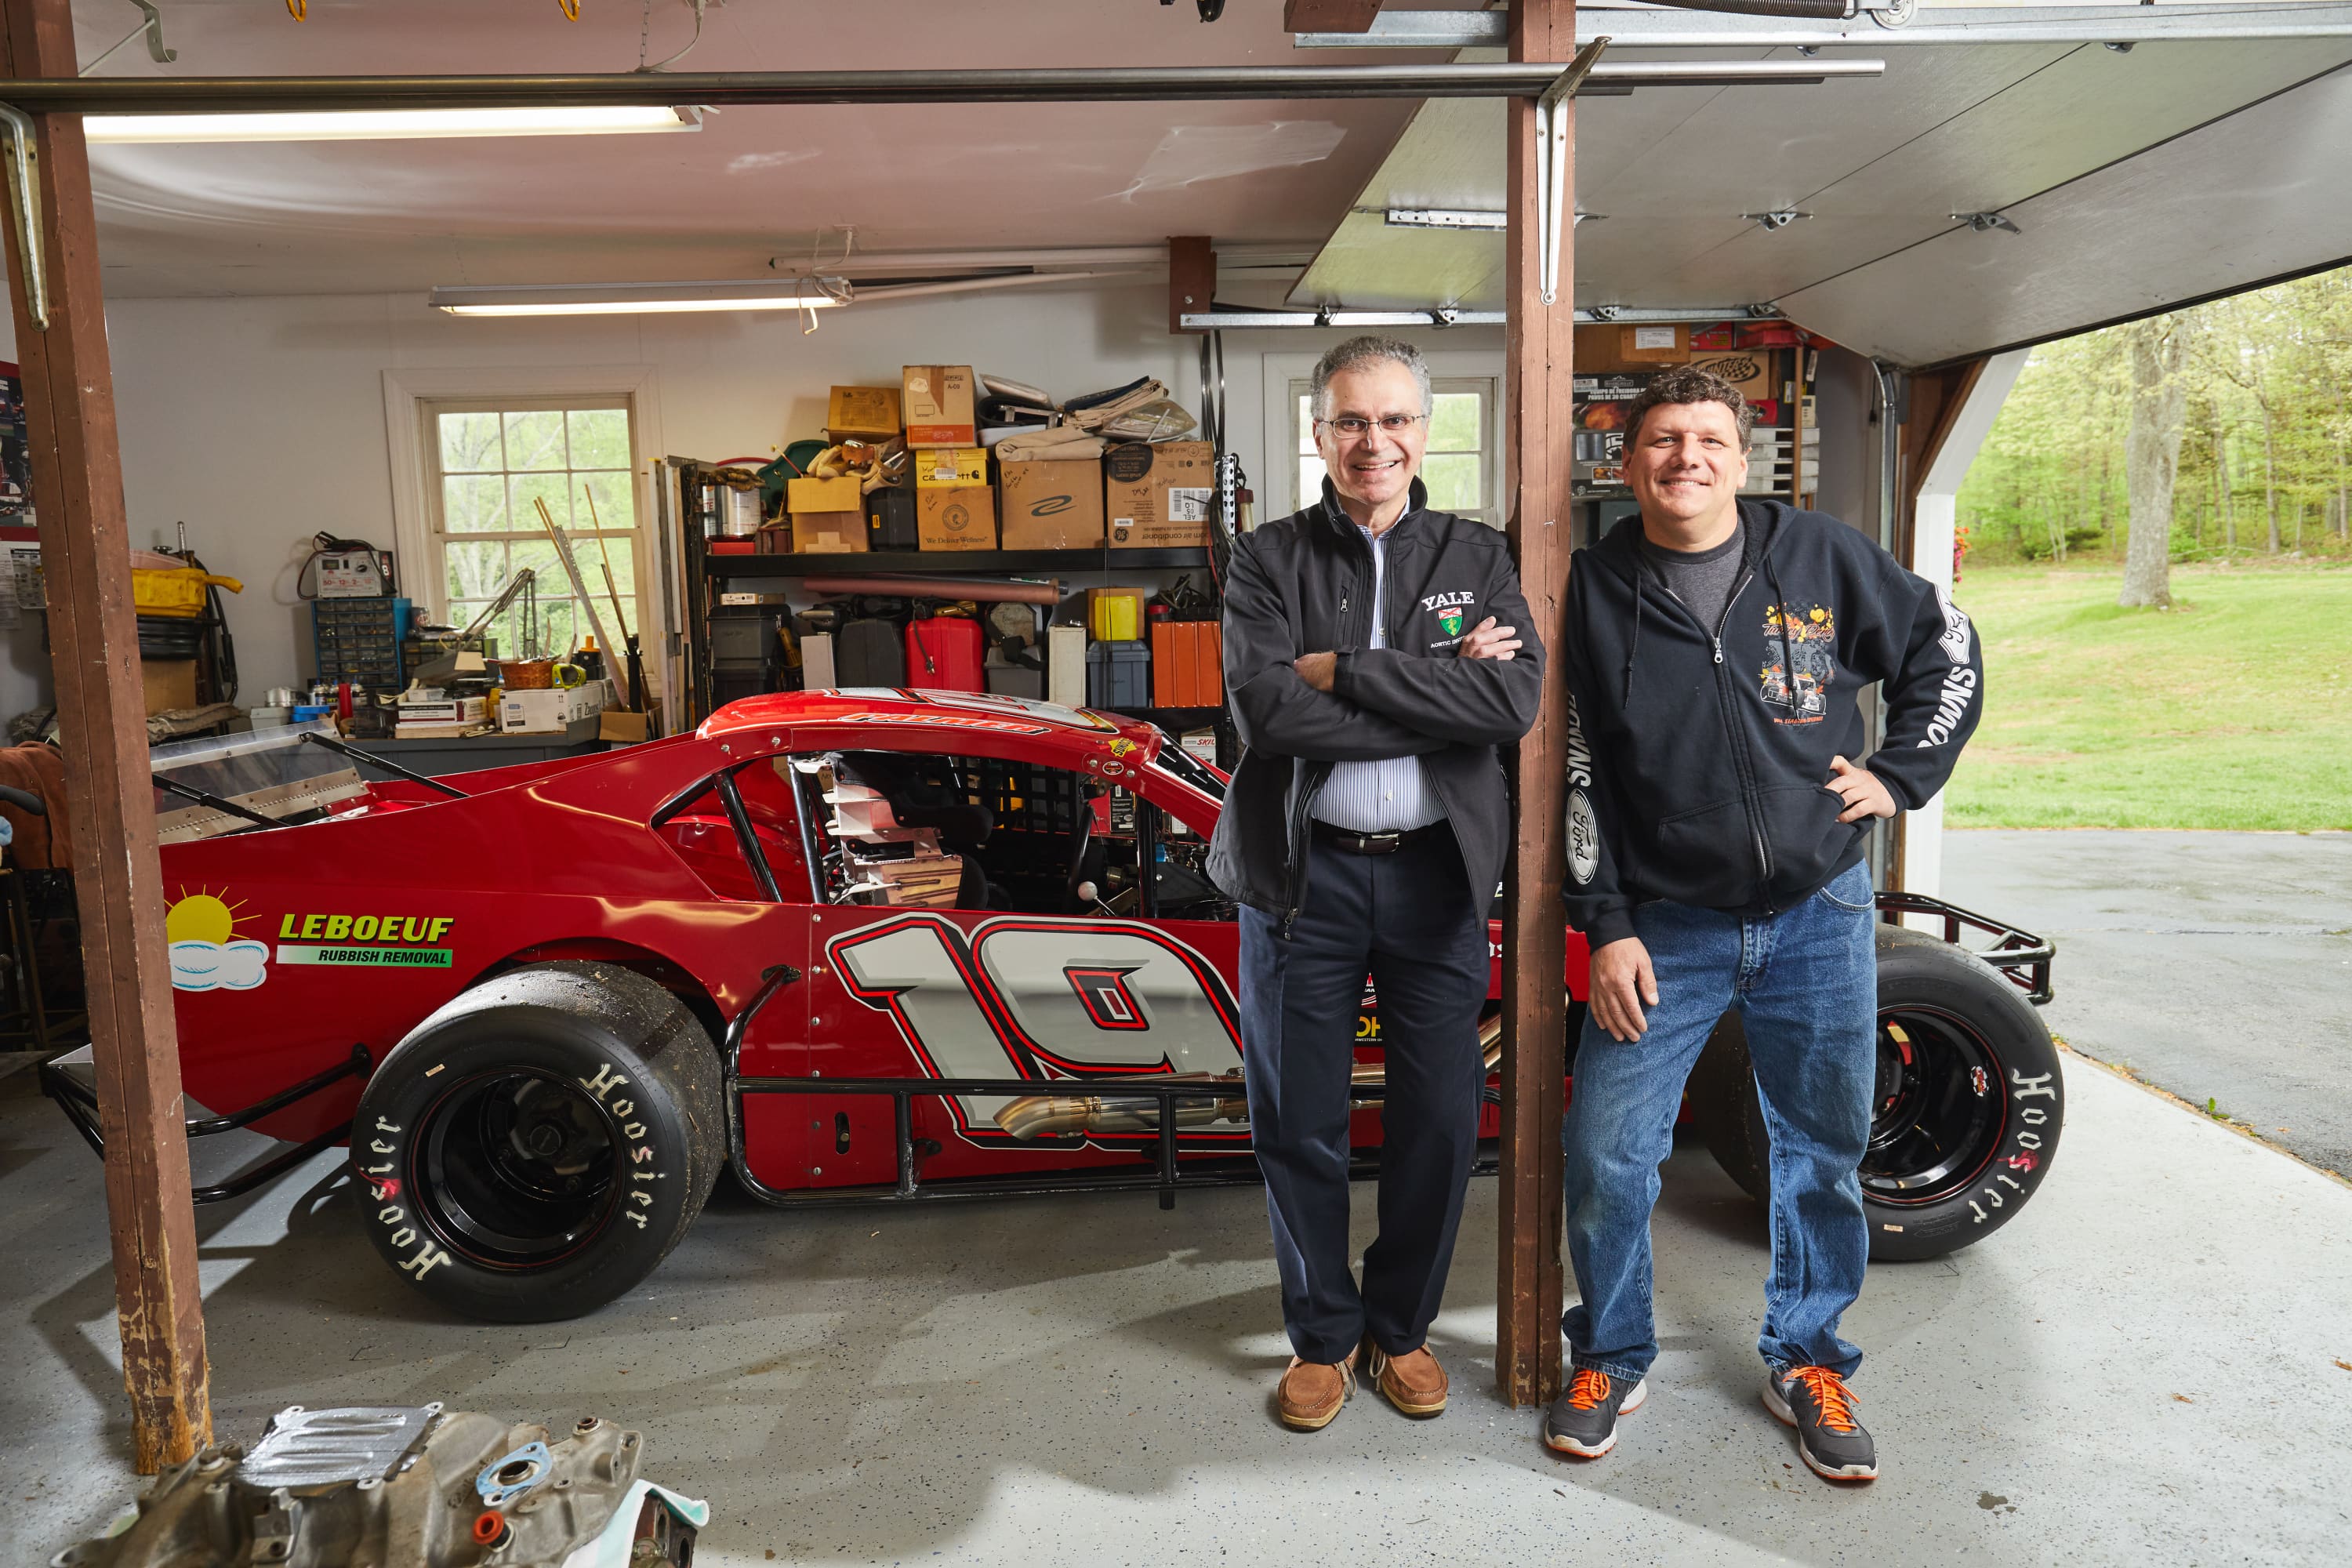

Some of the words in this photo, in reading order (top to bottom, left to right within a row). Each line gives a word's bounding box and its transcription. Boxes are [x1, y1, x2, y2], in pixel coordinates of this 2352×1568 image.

[1142, 532, 1182, 542] conditioner
[1421, 591, 1475, 612] YALE
[1430, 640, 1451, 648] AORTIC
[842, 713, 1051, 734] PALMER
[1573, 811, 1591, 862] Ford
[279, 913, 455, 944] LEBOEUF
[318, 949, 380, 963] RUBBISH
[383, 950, 448, 964] REMOVAL
[579, 1062, 666, 1229] Hoosier
[1969, 1068, 2056, 1224] Hoosier
[361, 1115, 453, 1281] Hoosier
